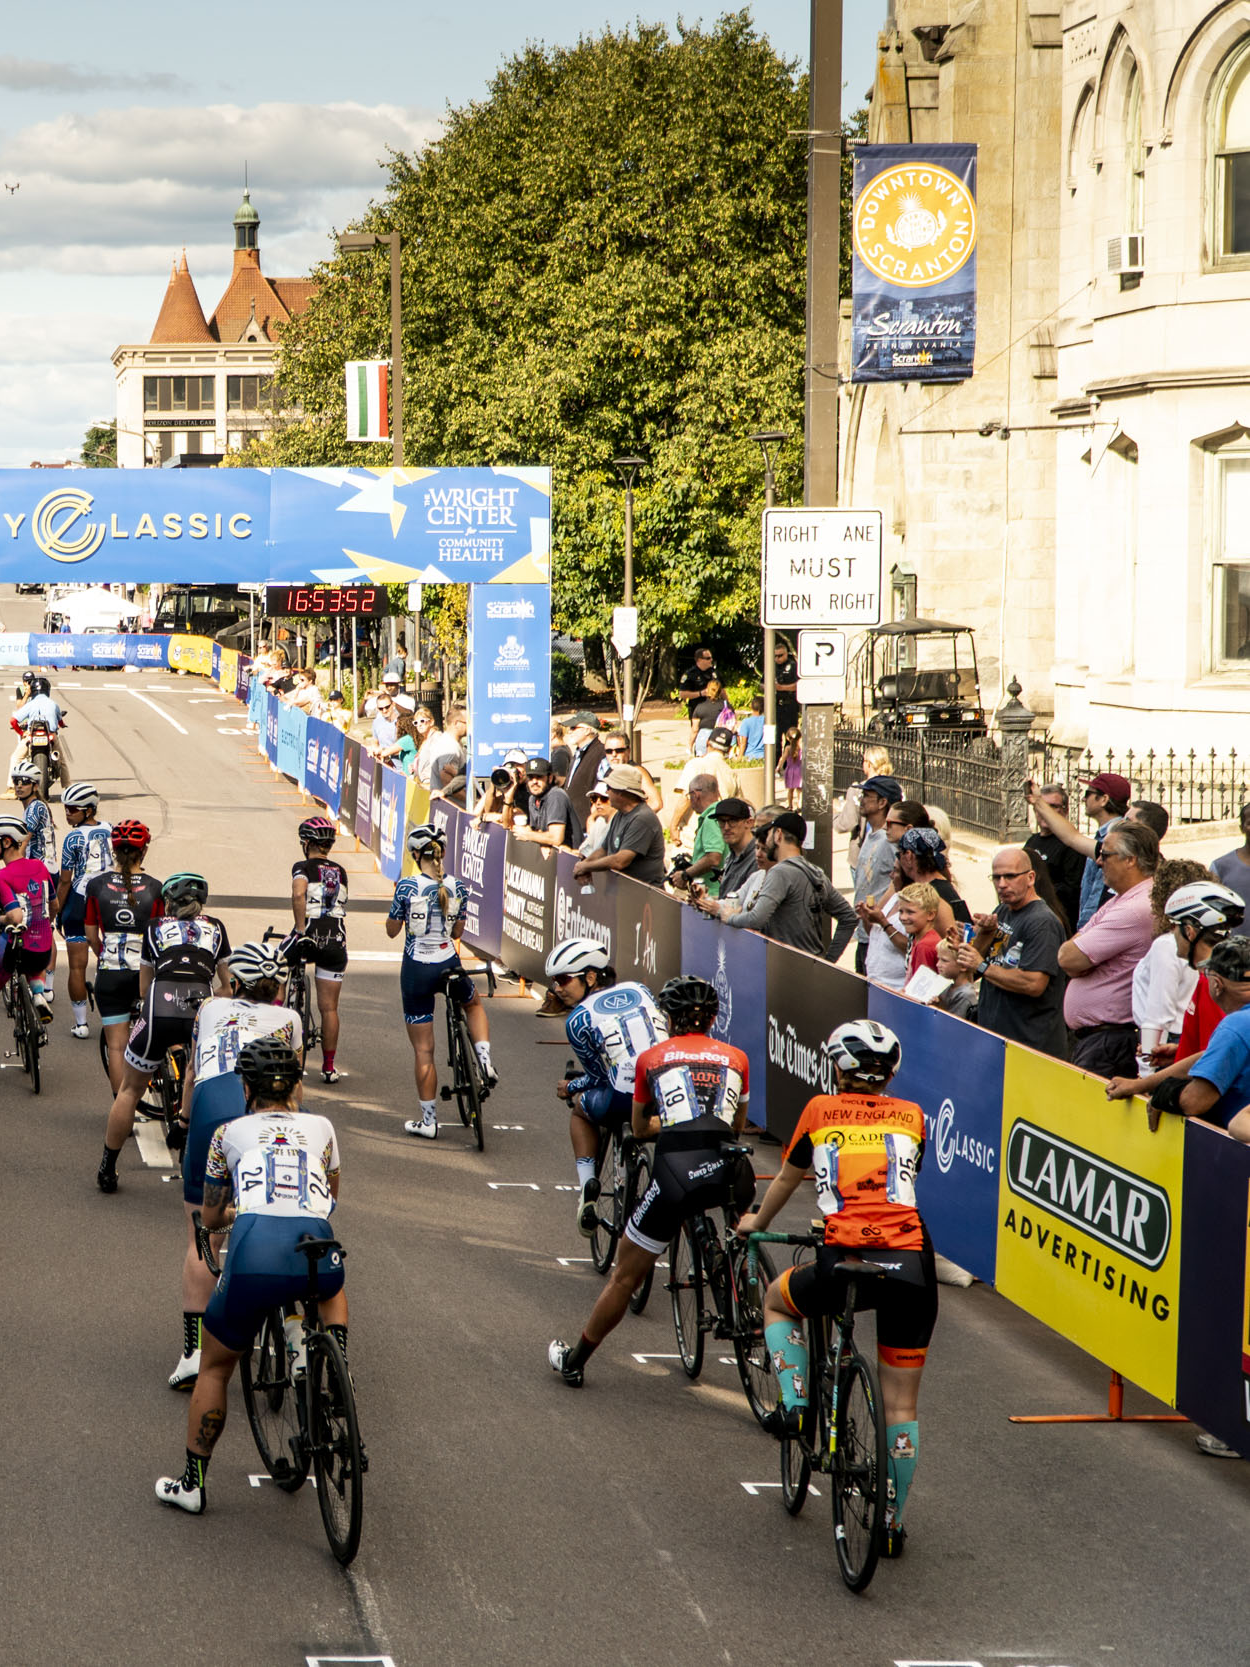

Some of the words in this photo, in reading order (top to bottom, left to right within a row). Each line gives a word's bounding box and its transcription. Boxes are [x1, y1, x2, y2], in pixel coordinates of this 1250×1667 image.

[861, 172, 963, 230] DOWNTOWN
[868, 220, 970, 280] SCRANTON
[866, 312, 962, 336] Scranton
[865, 341, 962, 349] PENNSYLVANIA
[428, 488, 519, 509] WRIGHT
[427, 507, 518, 527] CENTER
[438, 538, 505, 547] COMMUNITY
[773, 525, 820, 542] RIGHT
[438, 548, 505, 562] HEALTH
[790, 557, 857, 578] MUST
[287, 590, 375, 612] 16:53:52
[771, 594, 812, 610] TURN
[829, 592, 875, 610] RIGHT
[507, 863, 545, 902] LACKAWANNA
[411, 912, 426, 920] 8
[506, 889, 526, 921] COUNTY
[163, 925, 180, 940] 14
[521, 926, 543, 953] BUREAU
[565, 895, 611, 961] Entercom
[634, 921, 642, 966] I
[603, 1029, 623, 1048] 17
[769, 1013, 785, 1069] The
[663, 1050, 730, 1066] BikeReg
[664, 1085, 685, 1108] 19
[823, 1109, 853, 1120] NEW
[855, 1110, 914, 1124] ENGLAND
[240, 1166, 264, 1193] 24
[900, 1156, 914, 1182] 25
[815, 1167, 830, 1195] 25
[632, 1178, 662, 1227] BikeReg
[1017, 1134, 1151, 1253] LAMAR
[1003, 1208, 1171, 1323] ADVERTISING
